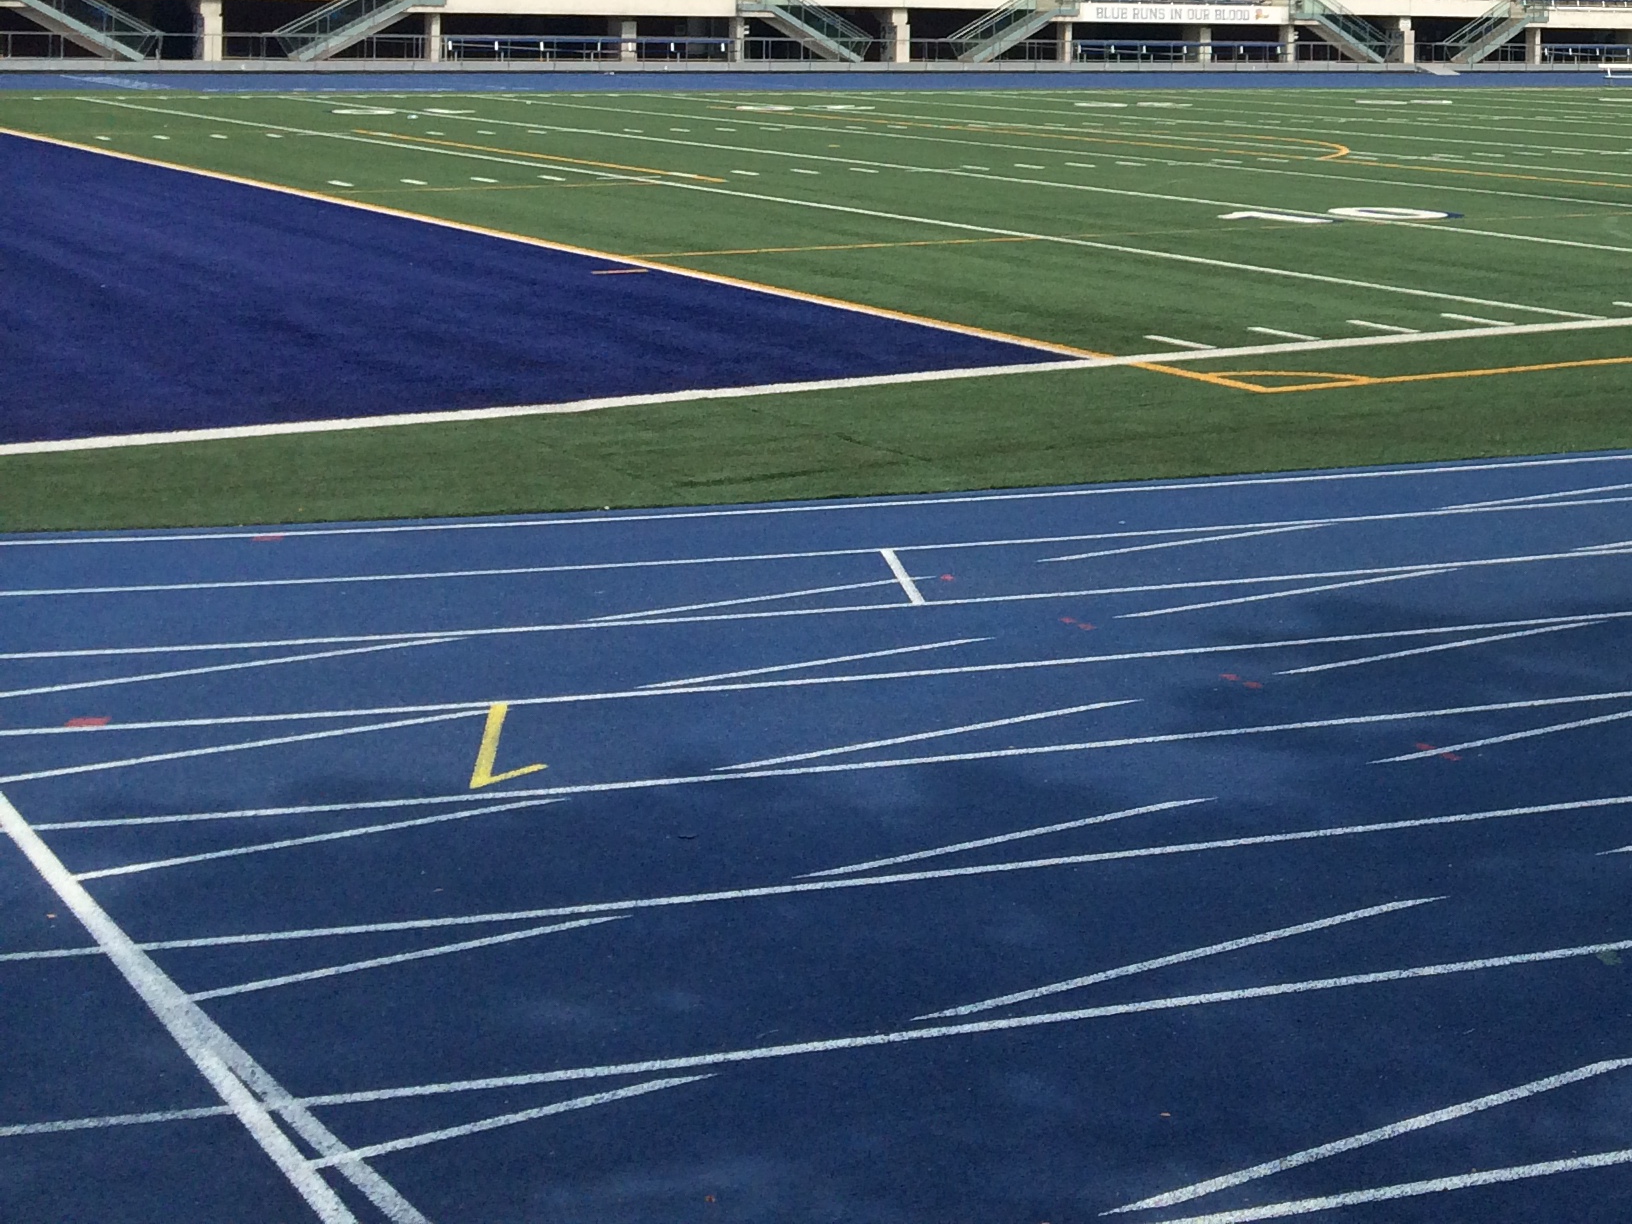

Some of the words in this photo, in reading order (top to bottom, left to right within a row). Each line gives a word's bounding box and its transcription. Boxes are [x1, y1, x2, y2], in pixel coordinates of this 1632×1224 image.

[1096, 6, 1128, 20] BLUE
[1132, 7, 1166, 21] RUNS
[1169, 8, 1183, 21] IN
[1187, 8, 1210, 21] OUR
[1214, 8, 1250, 22] BLOOD
[1217, 206, 1460, 224] 10
